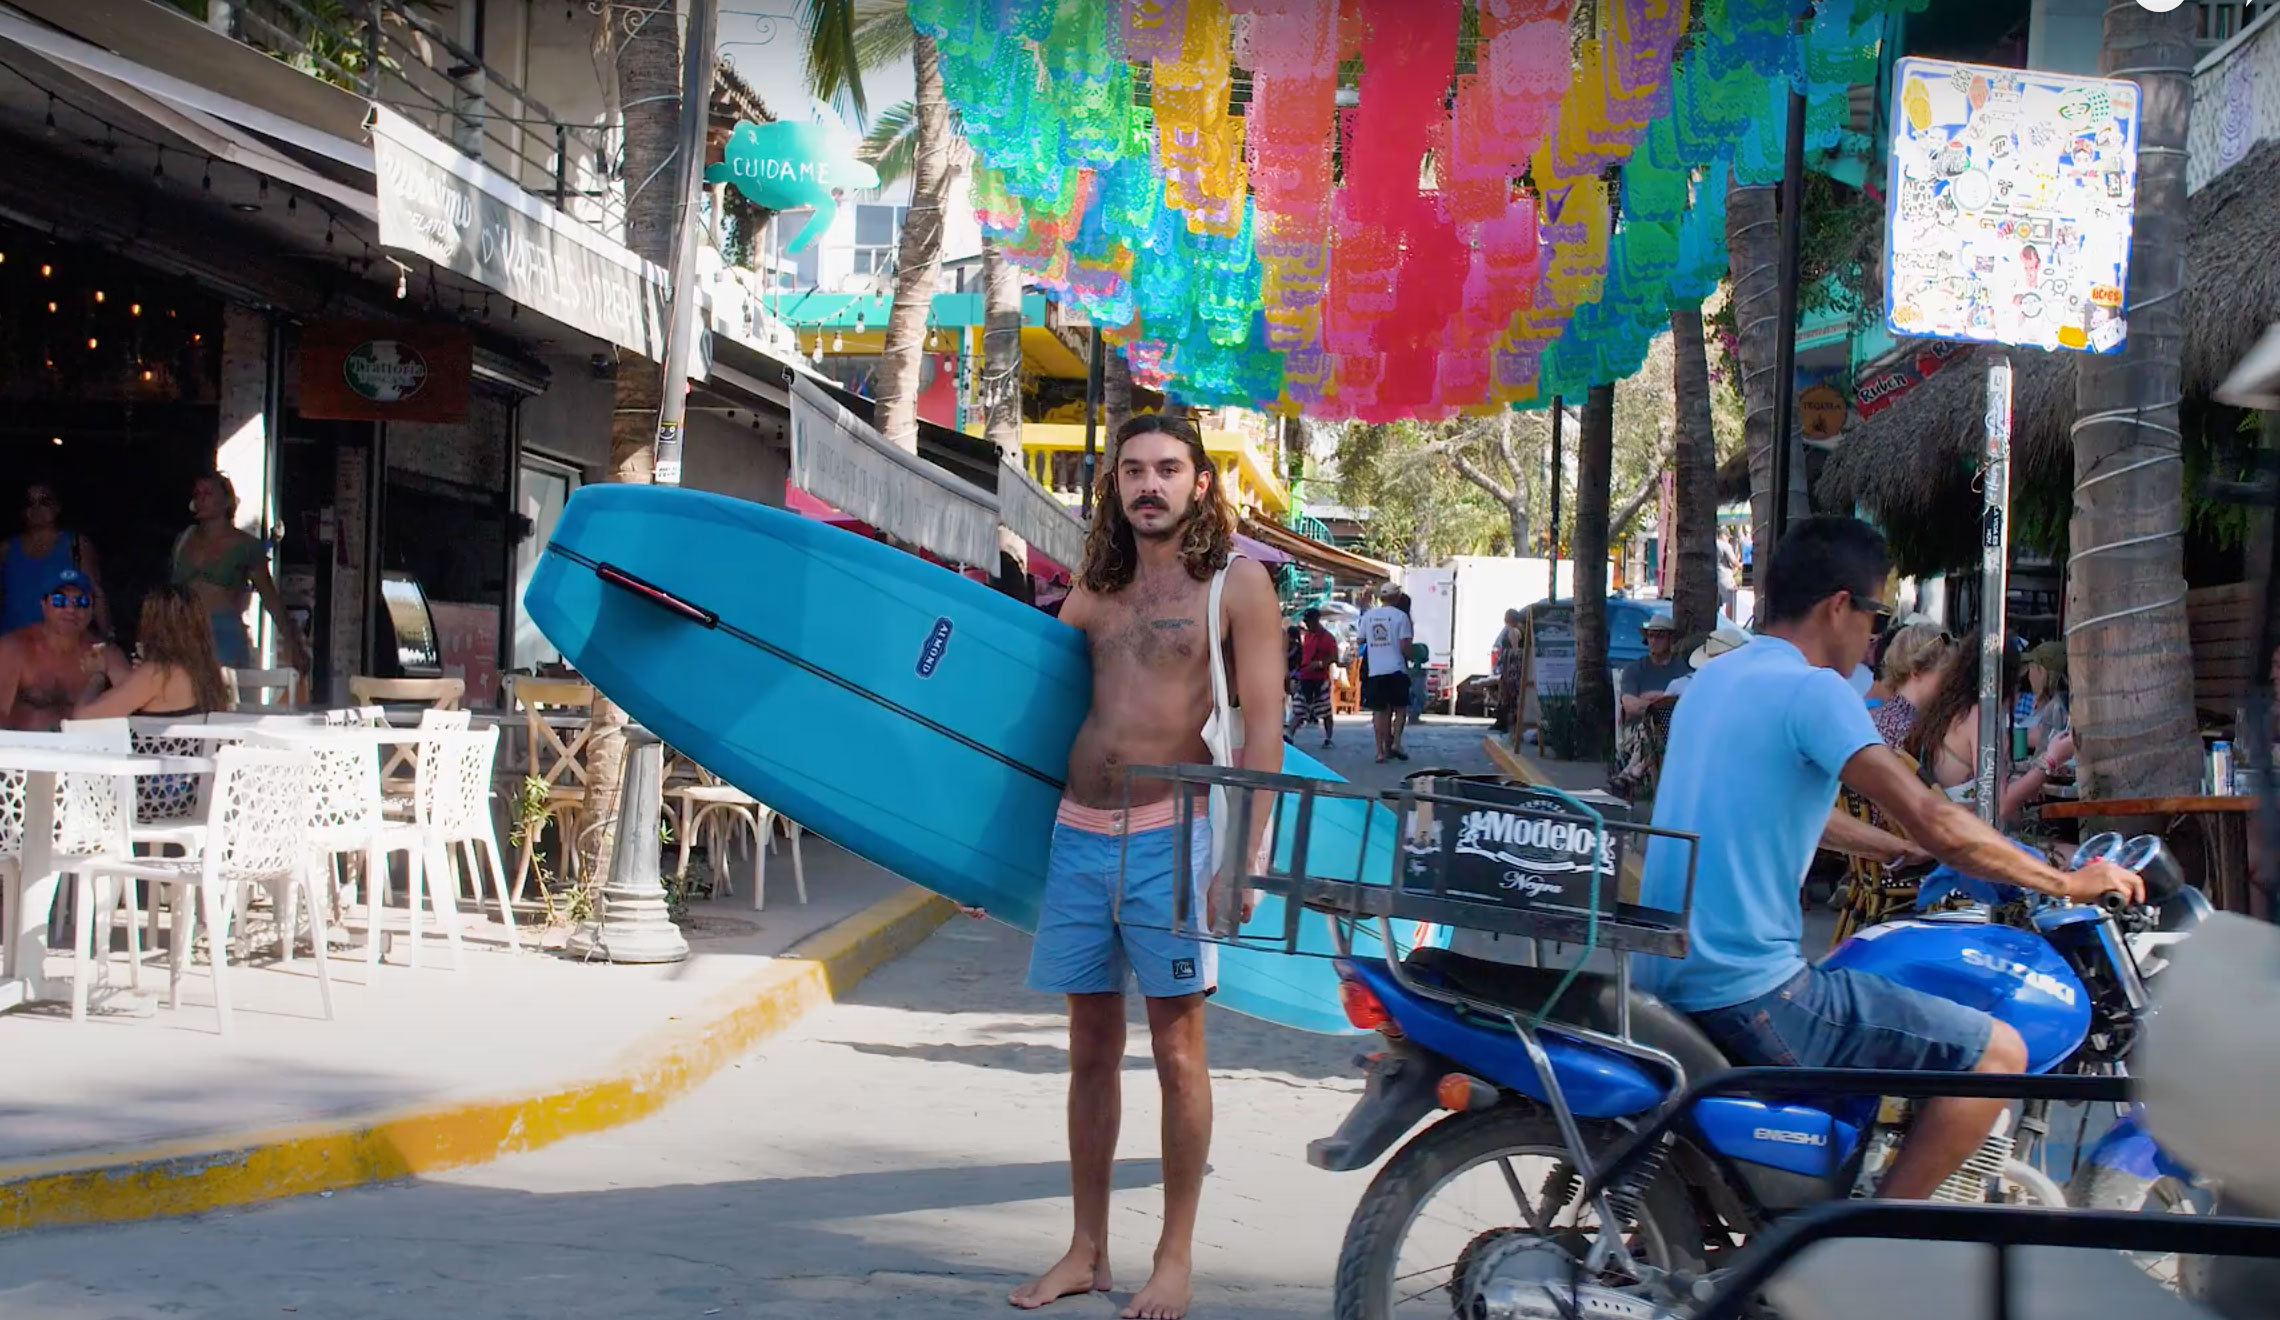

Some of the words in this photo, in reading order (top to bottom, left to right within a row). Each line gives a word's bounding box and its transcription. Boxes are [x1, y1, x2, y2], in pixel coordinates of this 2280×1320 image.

[495, 225, 580, 306] WAFFLES
[350, 356, 425, 378] Trattoria
[922, 624, 949, 673] ALMOND
[1482, 810, 1591, 855] Modelo
[1499, 870, 1565, 898] Negra
[1961, 948, 2075, 1006] SUZUKI
